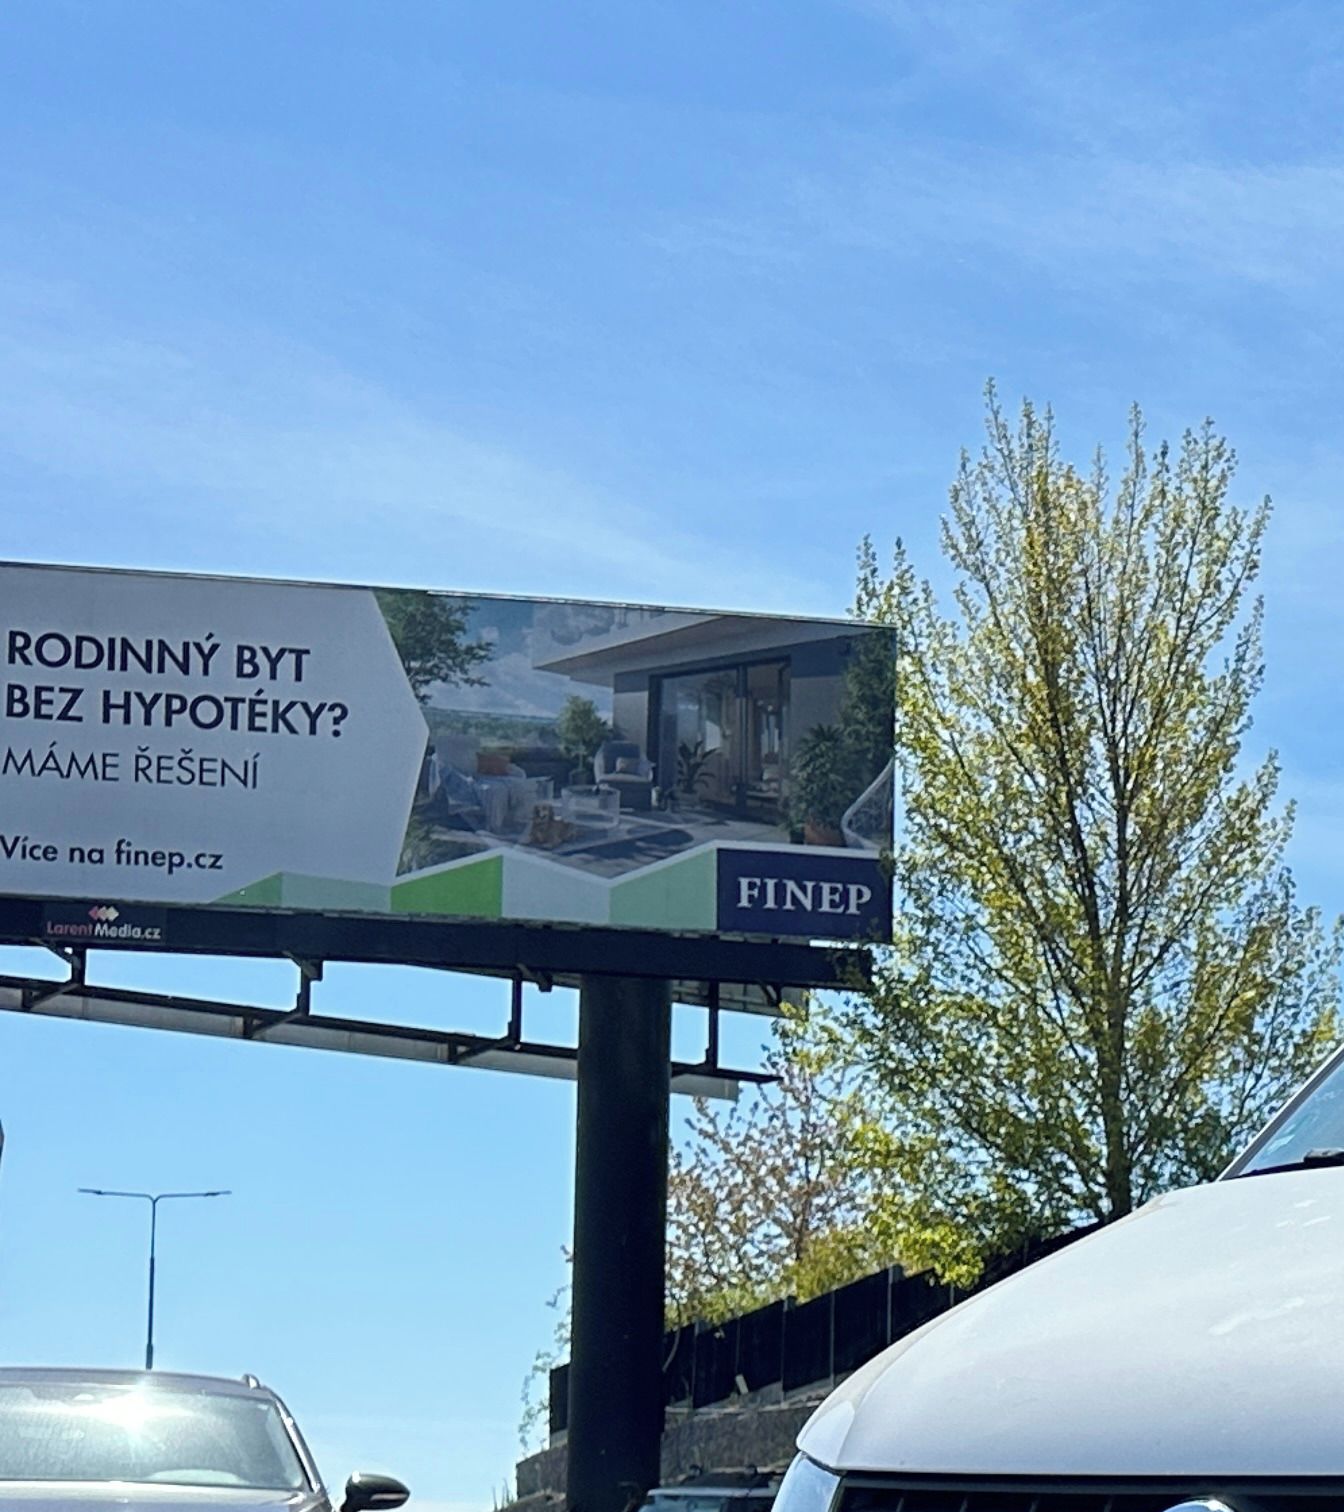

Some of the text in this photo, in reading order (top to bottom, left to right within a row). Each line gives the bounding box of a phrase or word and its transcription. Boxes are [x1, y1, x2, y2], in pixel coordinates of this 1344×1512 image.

[7, 630, 311, 682] RODINNÝ BYT
[5, 683, 349, 738] BEZ HYPOTÉKY?
[2, 741, 261, 789] MÁME ŘEŠENÍ
[0, 835, 224, 875] Více na finep.cz
[736, 876, 872, 915] FINEP
[47, 921, 161, 939] LarentMedia.cz
